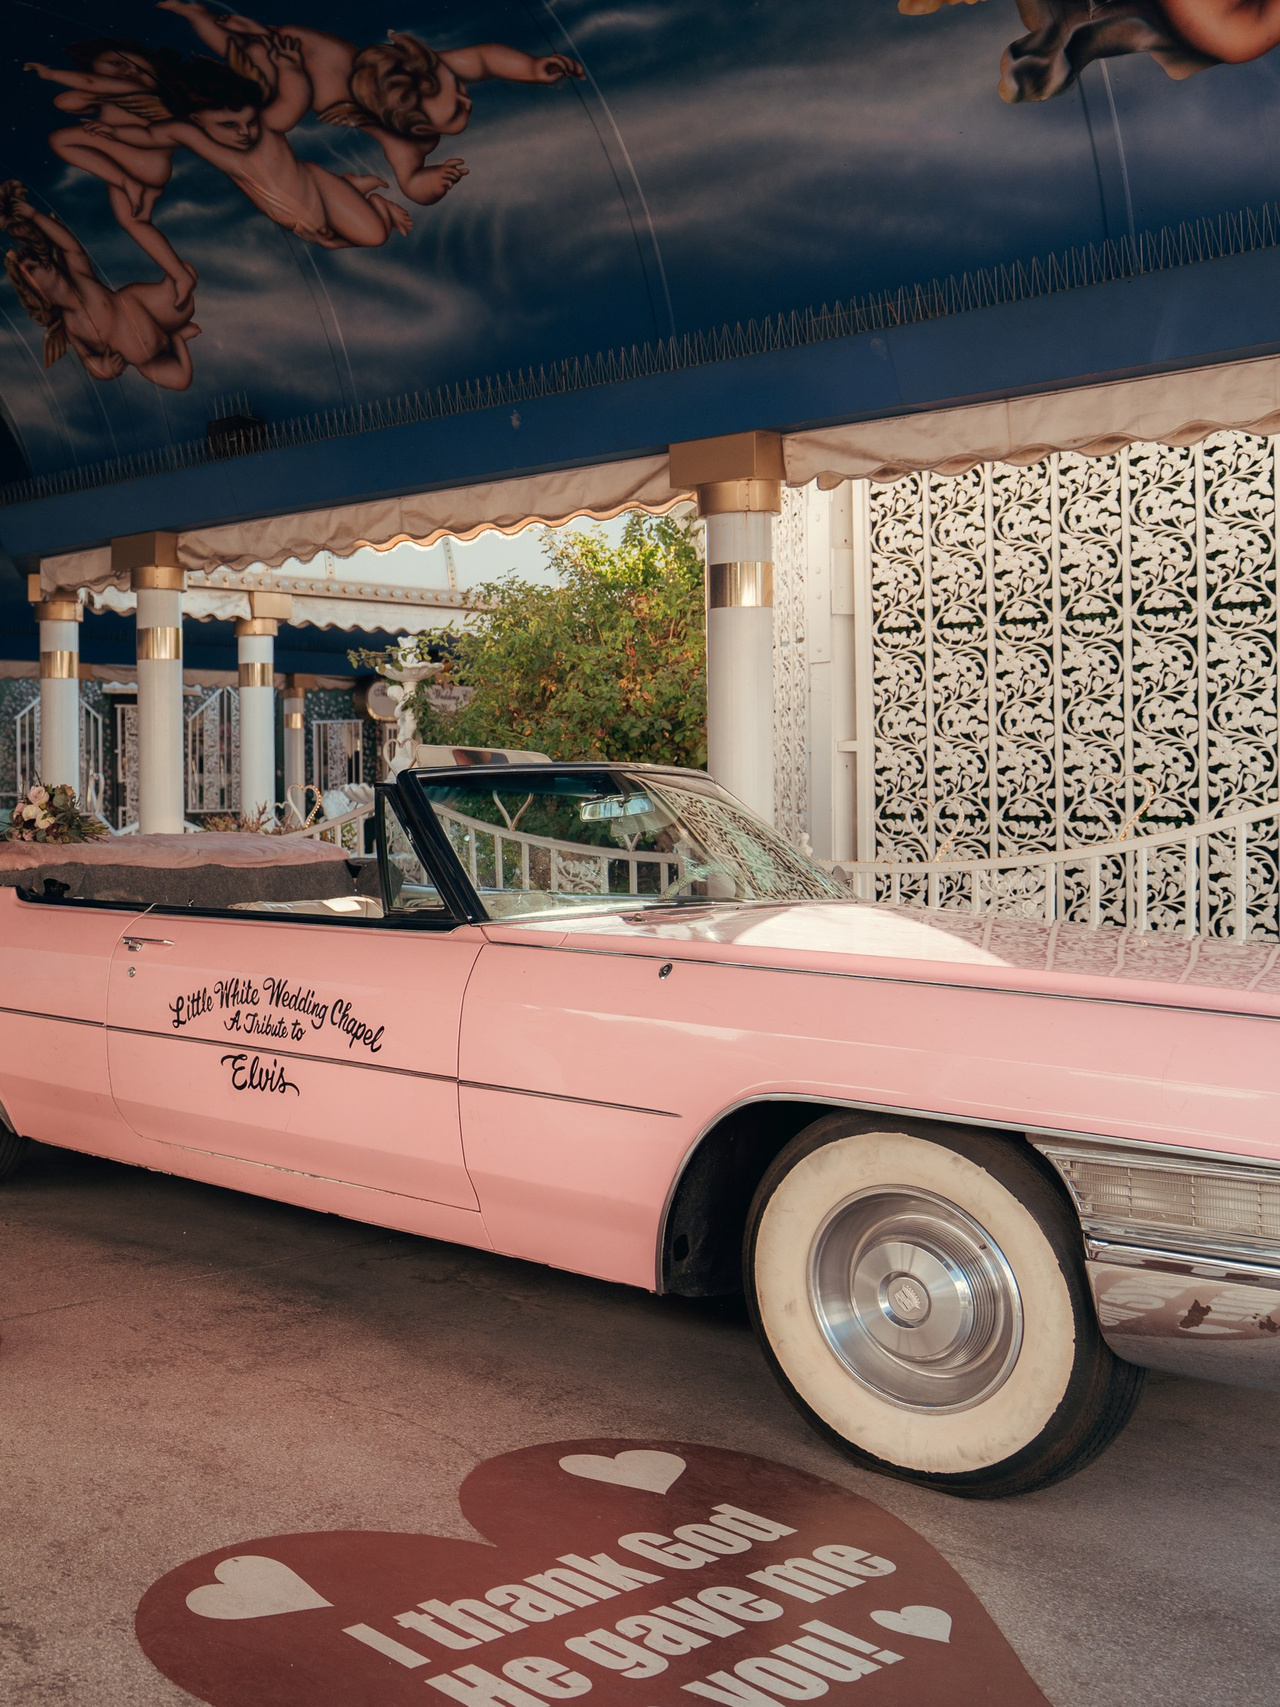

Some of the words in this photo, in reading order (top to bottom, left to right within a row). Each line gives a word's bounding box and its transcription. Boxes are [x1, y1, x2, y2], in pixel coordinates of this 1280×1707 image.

[169, 987, 214, 1029] Little
[213, 977, 260, 1009] White
[262, 977, 329, 1030] Wedding
[329, 999, 385, 1053] Chapel
[223, 1010, 241, 1031] A
[243, 1012, 289, 1039] Tribute
[291, 1019, 306, 1041] to
[220, 1054, 300, 1096] Elvis
[341, 1622, 432, 1669] I
[392, 1552, 665, 1650] thank
[617, 1503, 799, 1570] God
[424, 1656, 593, 1707] He
[564, 1586, 784, 1679] gave
[745, 1544, 897, 1603] me
[679, 1619, 905, 1707] you!
